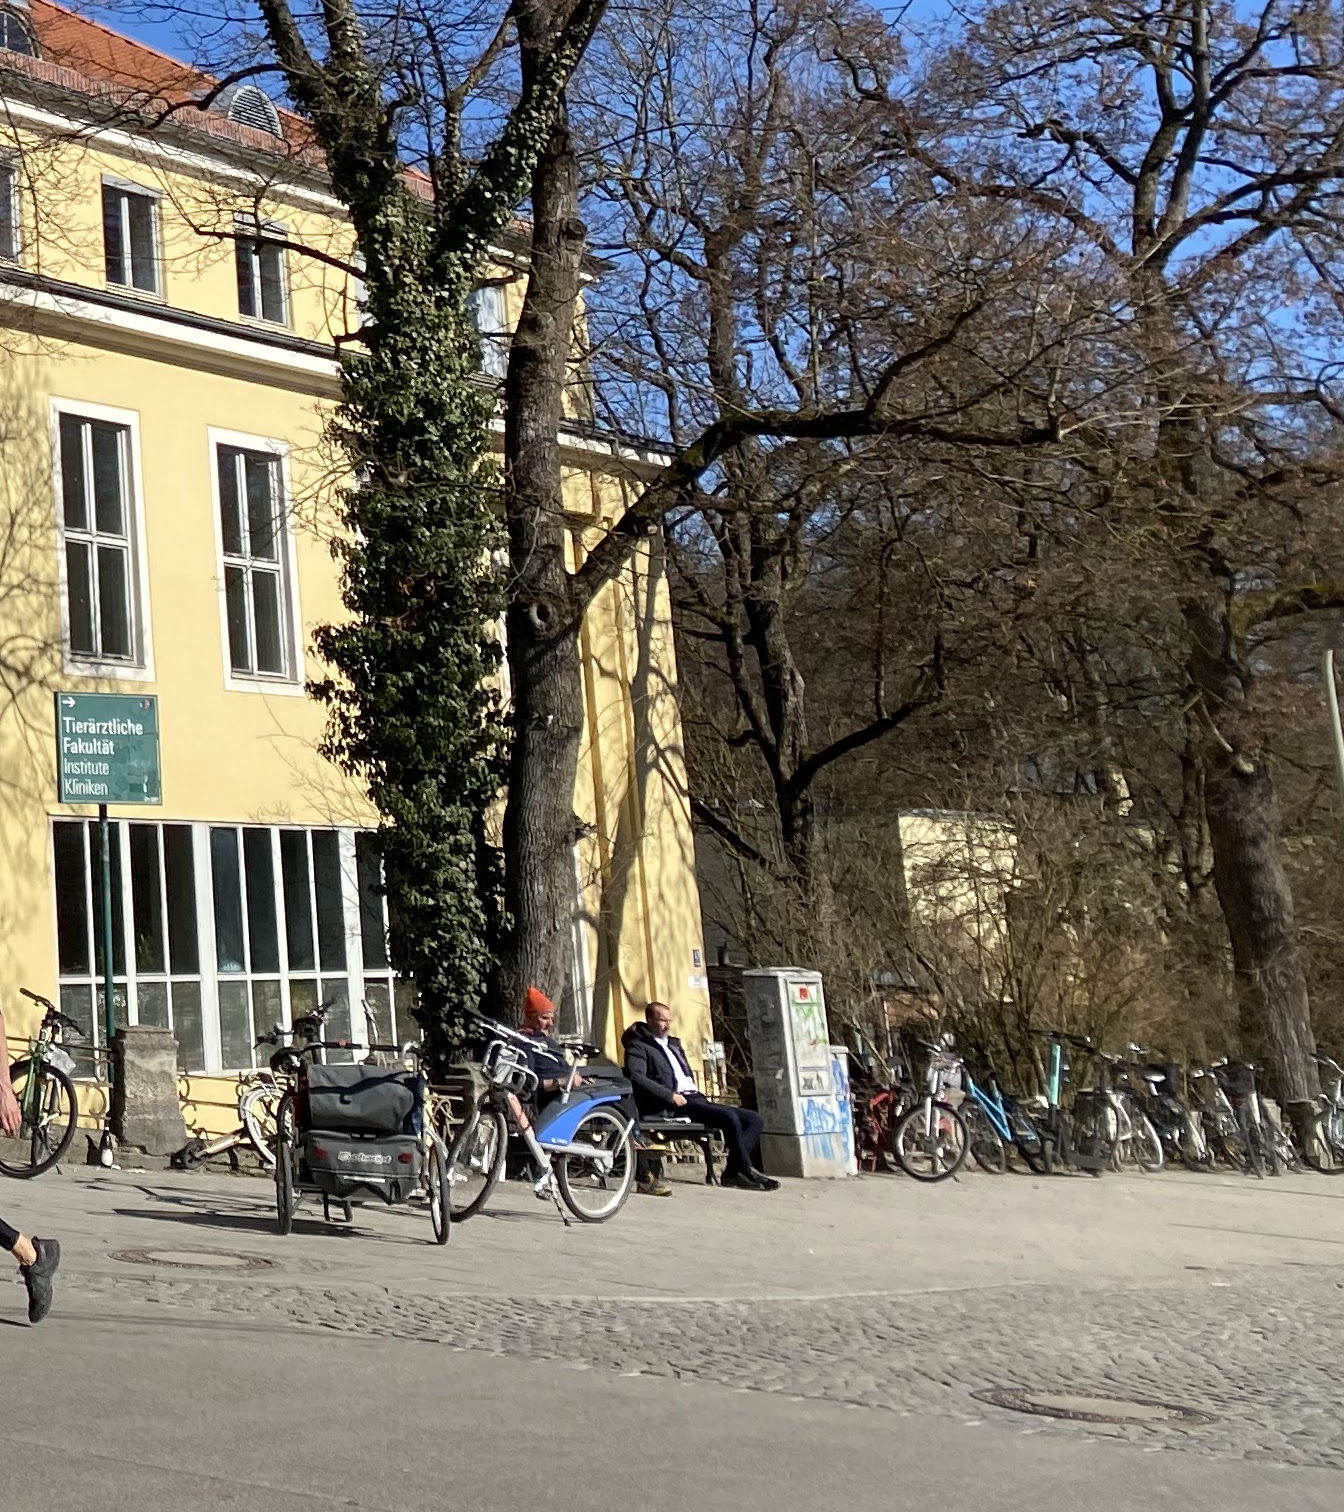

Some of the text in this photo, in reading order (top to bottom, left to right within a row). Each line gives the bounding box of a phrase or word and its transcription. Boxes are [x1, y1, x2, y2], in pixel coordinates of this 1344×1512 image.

[62, 717, 144, 736] Tierärztliche
[63, 737, 115, 756] Fakultät
[64, 758, 110, 776] Institute
[64, 778, 108, 796] Kliniken
